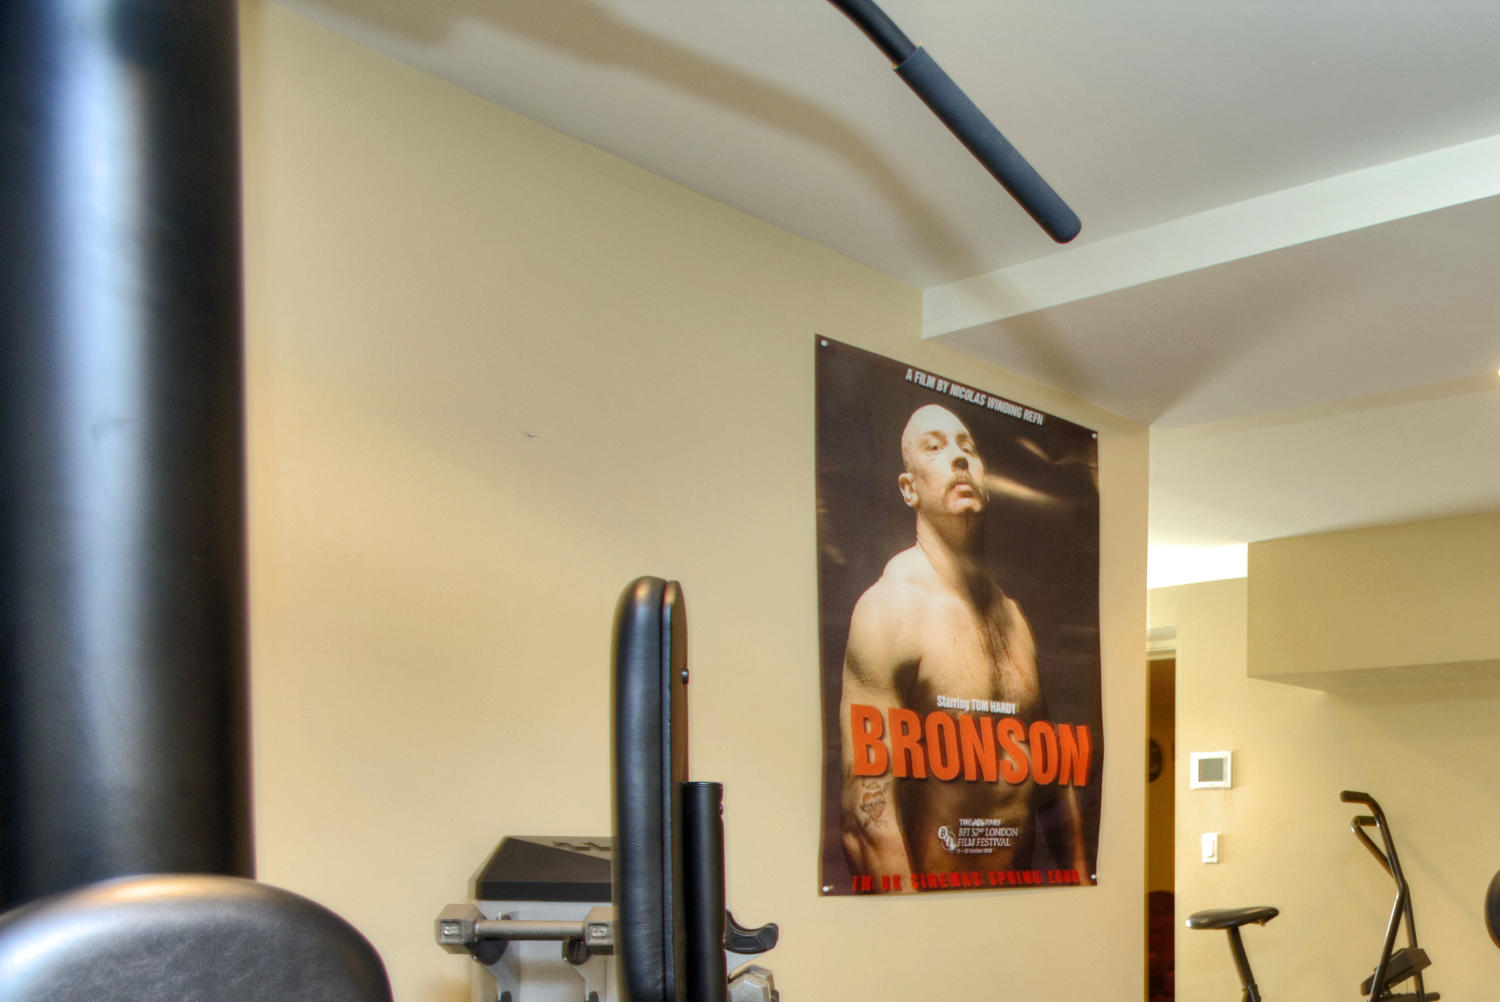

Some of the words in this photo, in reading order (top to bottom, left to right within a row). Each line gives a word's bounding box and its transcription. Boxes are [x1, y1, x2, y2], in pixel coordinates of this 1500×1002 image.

[906, 368, 913, 381] A
[914, 371, 935, 390] FILM
[936, 378, 950, 393] BY
[949, 383, 986, 406] NICOLAS
[987, 395, 1023, 418] WINDING
[1023, 408, 1044, 425] REFN
[971, 699, 989, 712] TOM
[990, 701, 1016, 715] HARDY
[850, 703, 1092, 787] BRONSON
[985, 827, 1018, 837] LONDON
[957, 838, 975, 847] FILM
[976, 838, 1012, 847] FESTIVAL
[910, 871, 981, 891] CINEMAS
[987, 869, 1042, 886] SPRING
